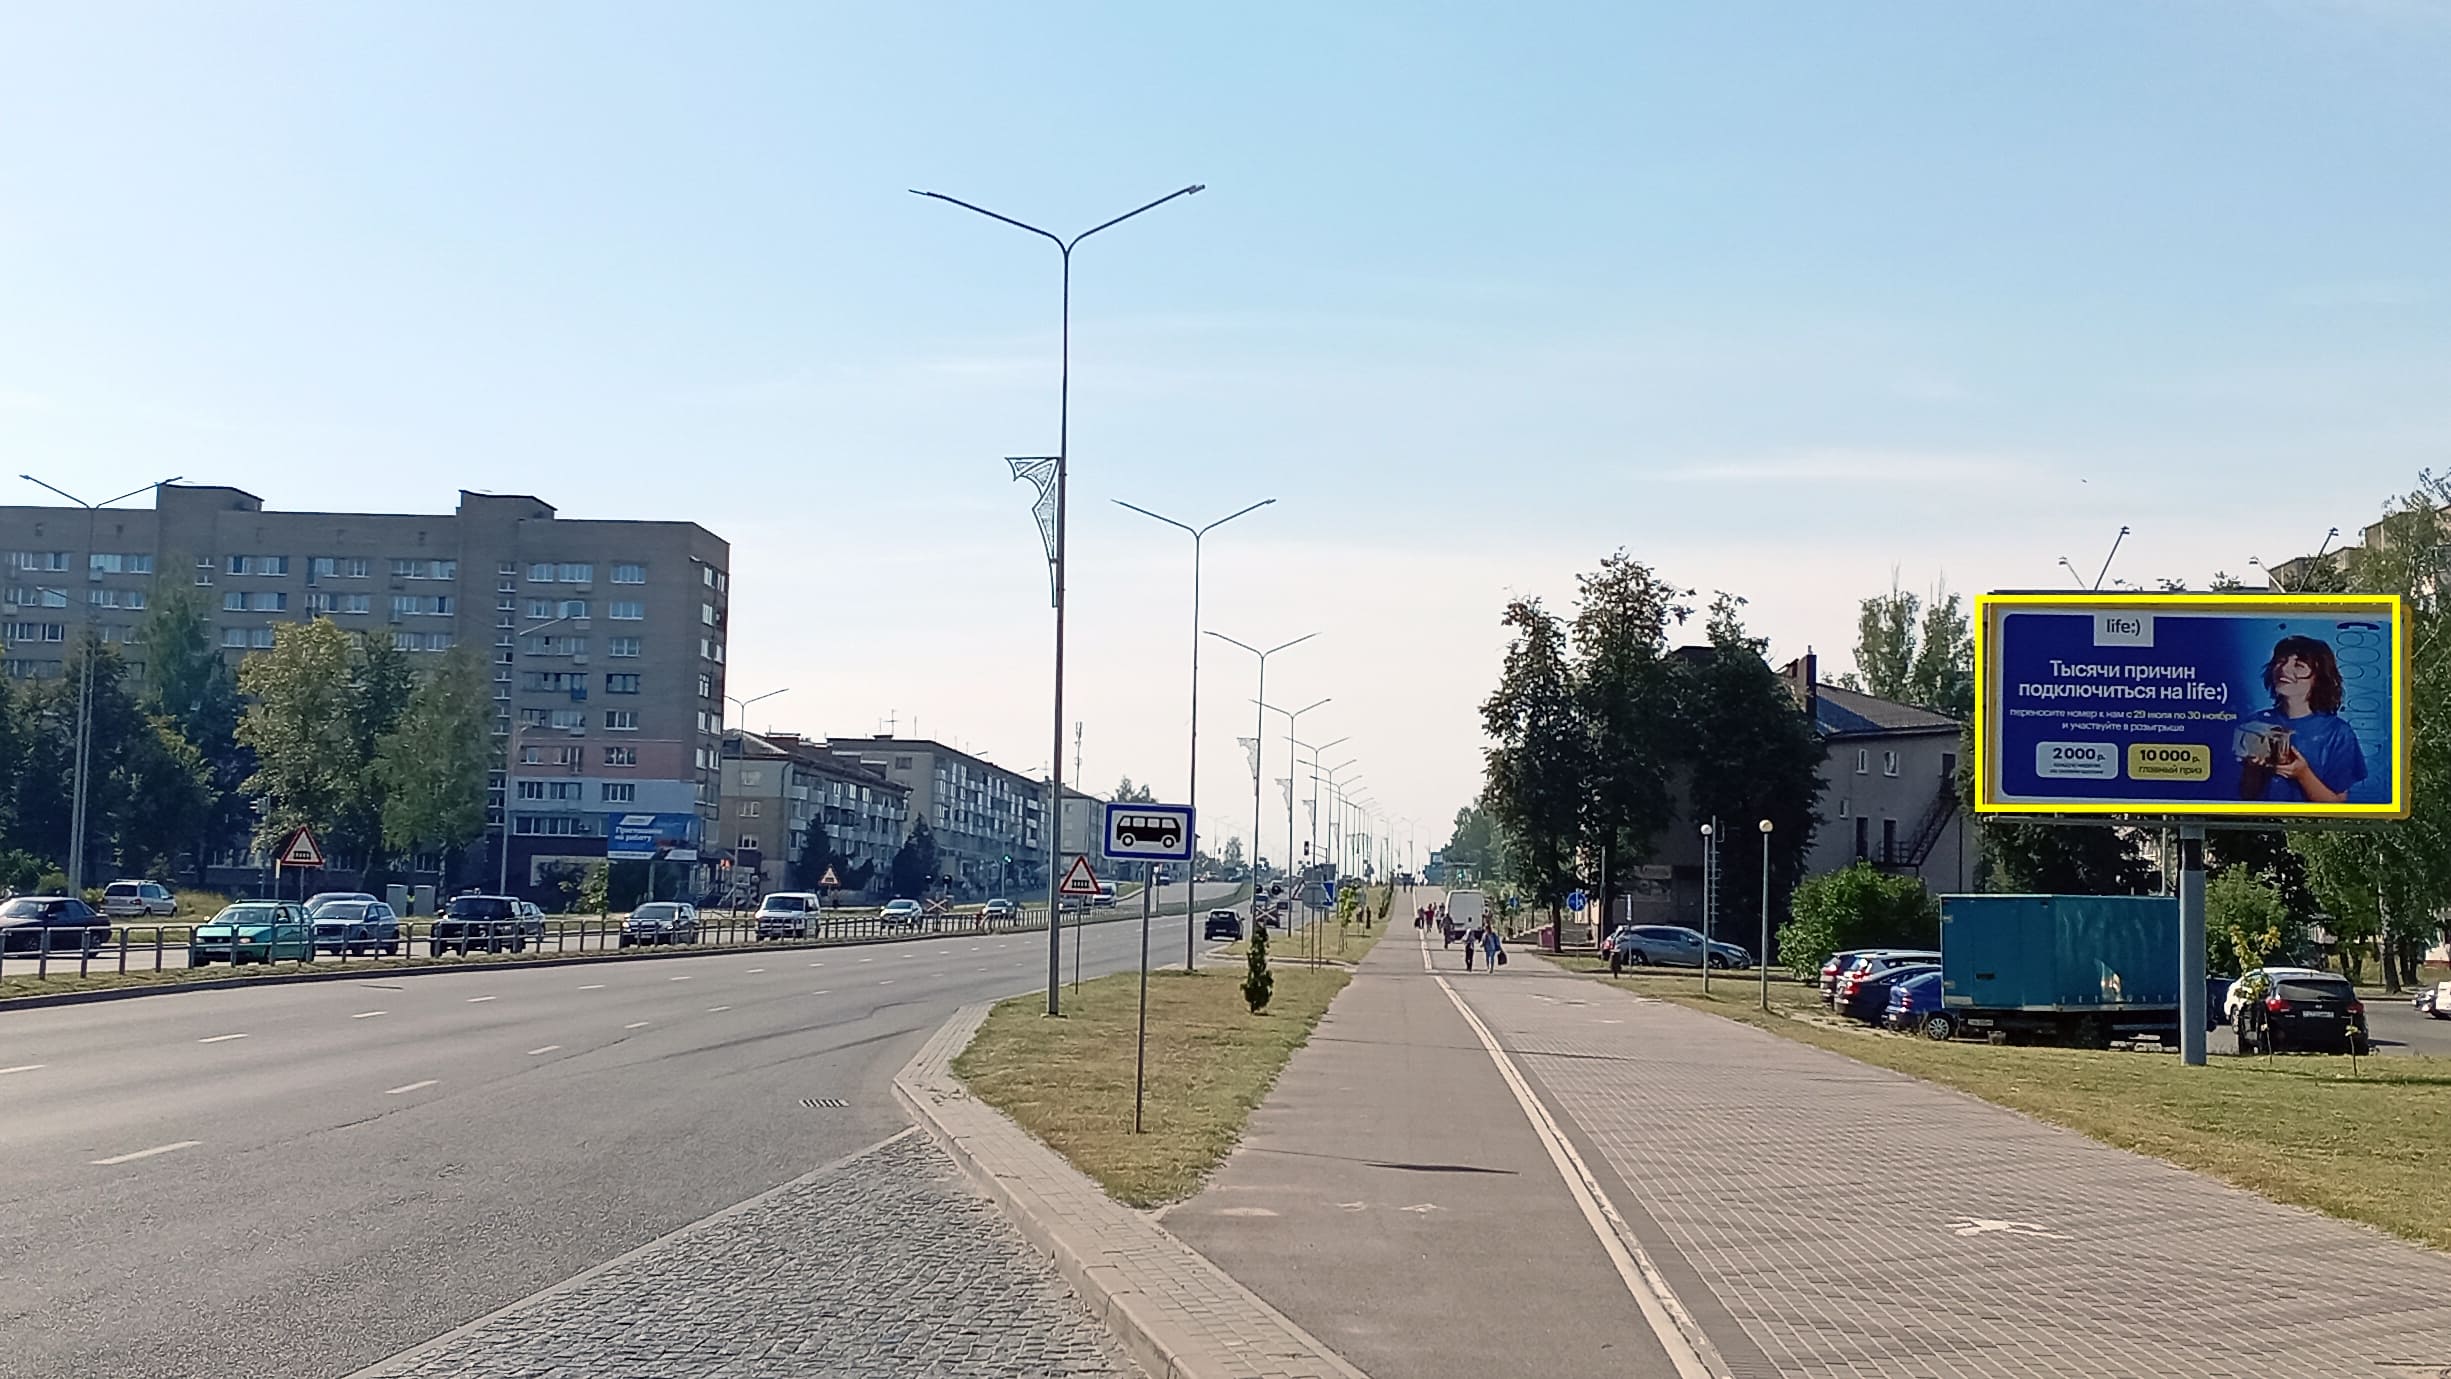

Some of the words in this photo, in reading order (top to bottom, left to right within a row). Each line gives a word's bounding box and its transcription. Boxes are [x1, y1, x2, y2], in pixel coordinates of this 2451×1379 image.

[2106, 618, 2141, 637] life:)
[2049, 659, 2120, 679] Тысячи
[2124, 664, 2196, 682] причин
[2018, 683, 2156, 699] подключиться
[2160, 686, 2183, 700] на
[2187, 682, 2229, 704] life:)
[2067, 710, 2097, 720] номер
[2187, 710, 2201, 720] 30
